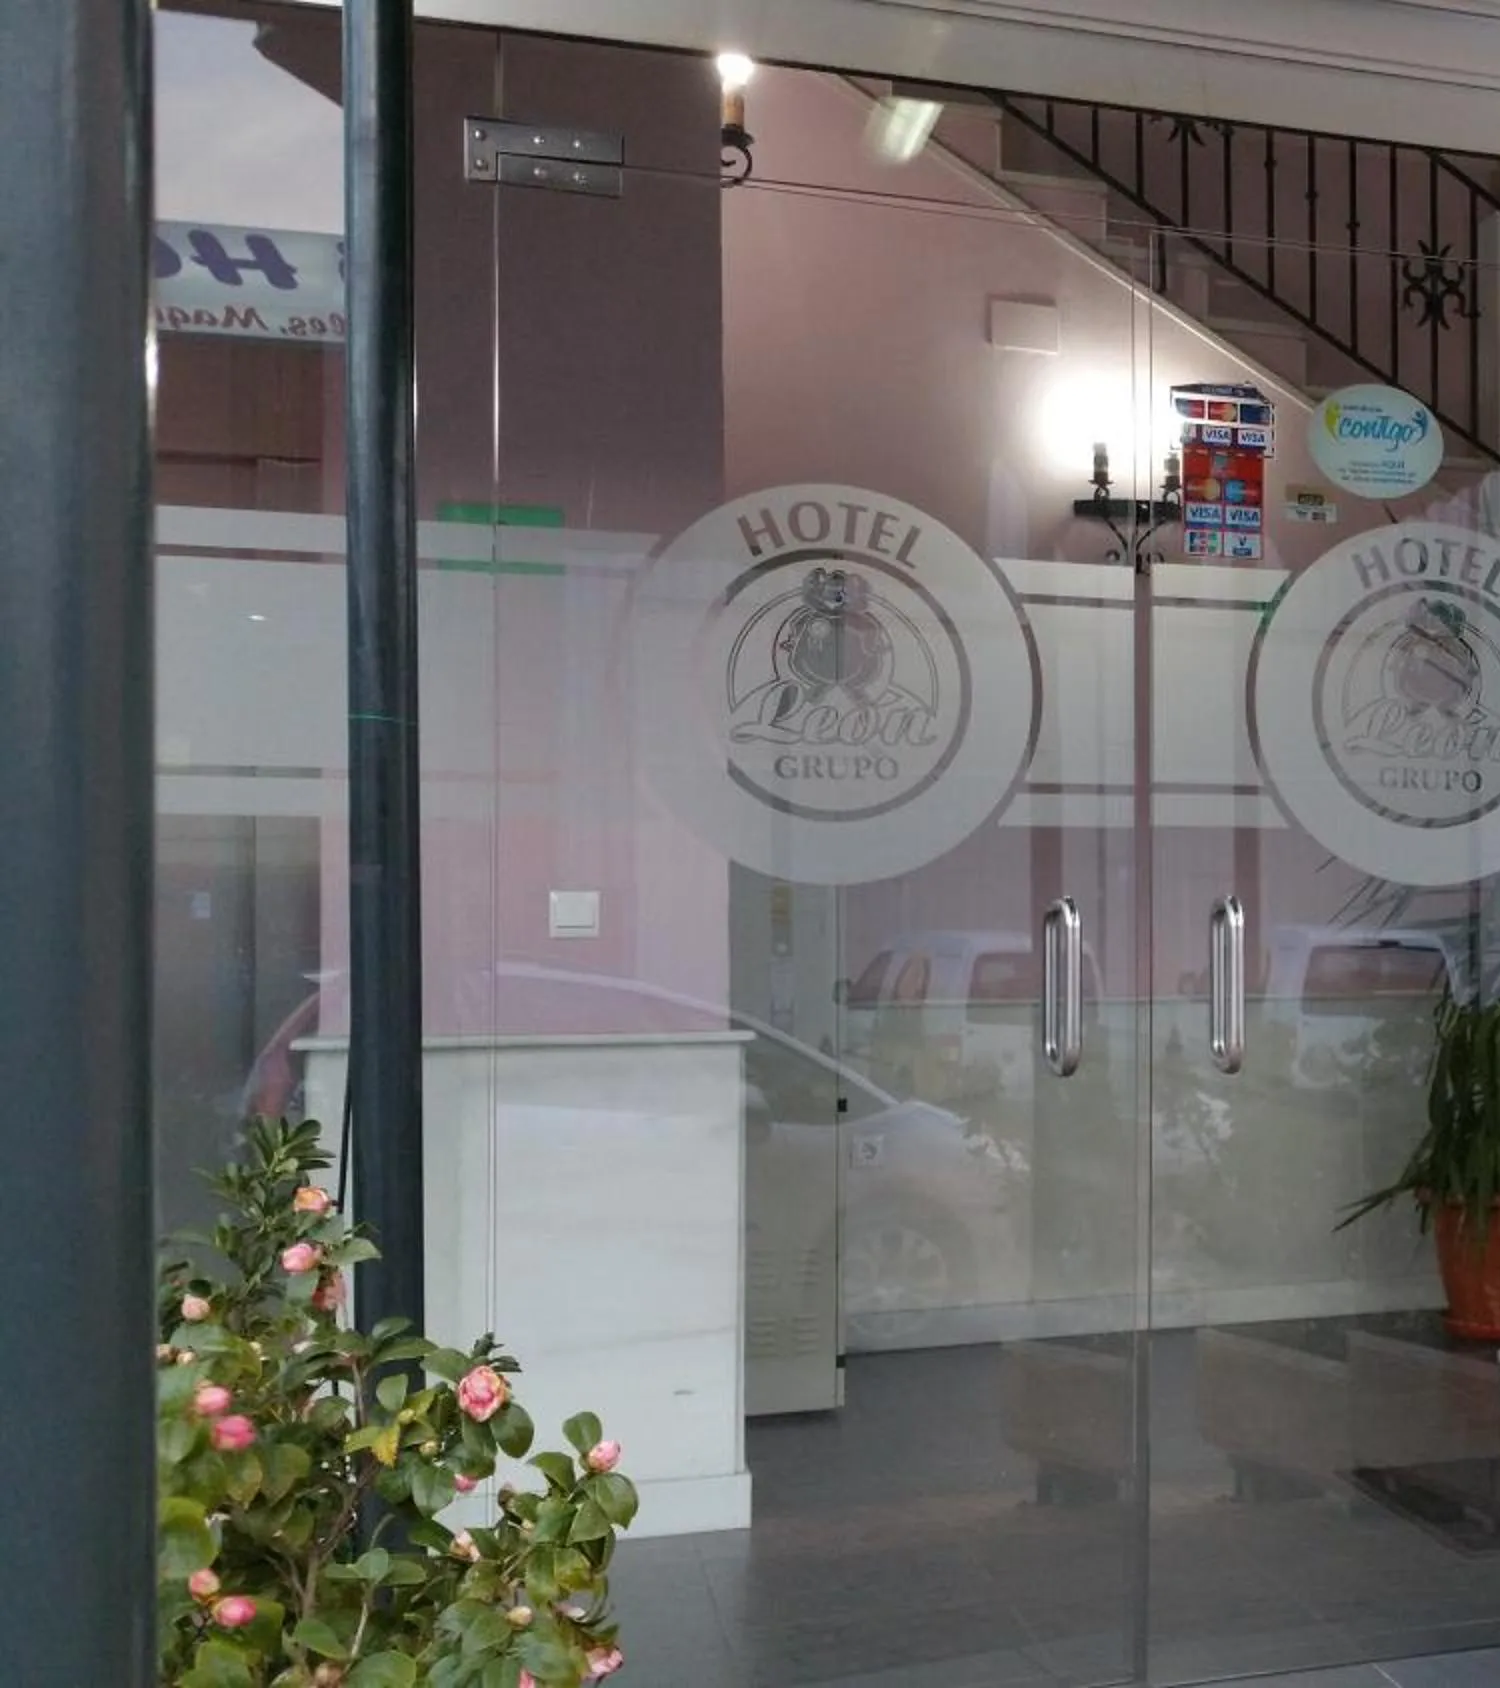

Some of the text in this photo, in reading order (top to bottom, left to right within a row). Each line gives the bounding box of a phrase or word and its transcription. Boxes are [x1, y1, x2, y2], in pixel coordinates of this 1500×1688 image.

[1205, 427, 1230, 440] VISA
[1189, 506, 1221, 519] VISA
[1230, 509, 1260, 523] VISA
[737, 501, 922, 569] HOTEL
[773, 755, 899, 781] GRUPO
[1379, 766, 1483, 793] GRUPO
